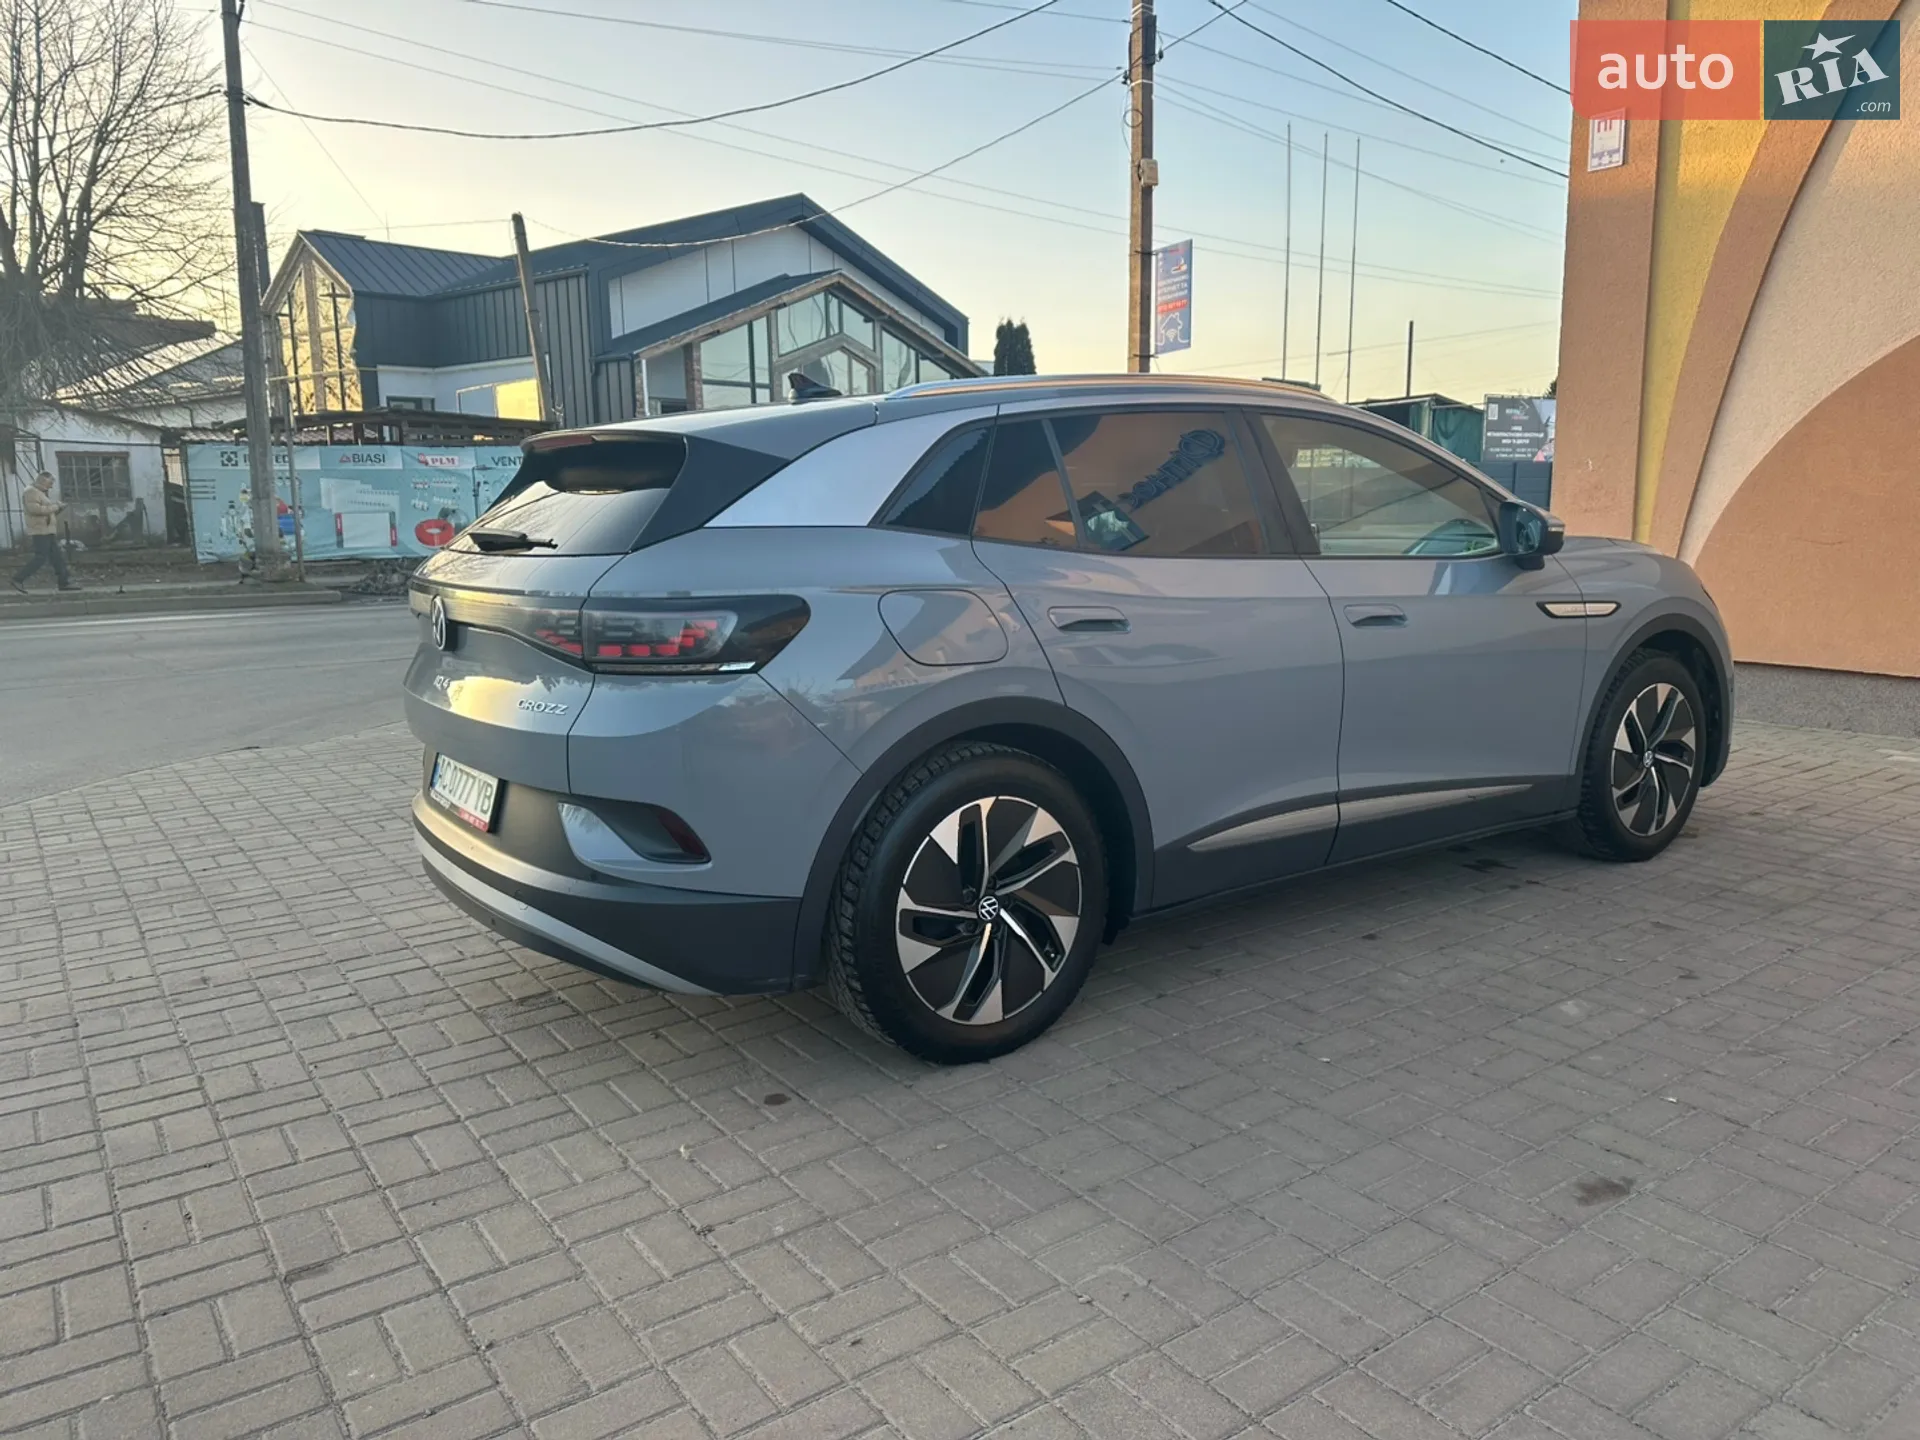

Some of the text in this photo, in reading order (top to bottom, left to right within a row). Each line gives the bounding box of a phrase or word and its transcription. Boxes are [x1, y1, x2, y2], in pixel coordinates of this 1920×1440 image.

[352, 453, 386, 464] BIASI
[431, 456, 456, 466] PLM
[516, 698, 568, 715] CROZZ
